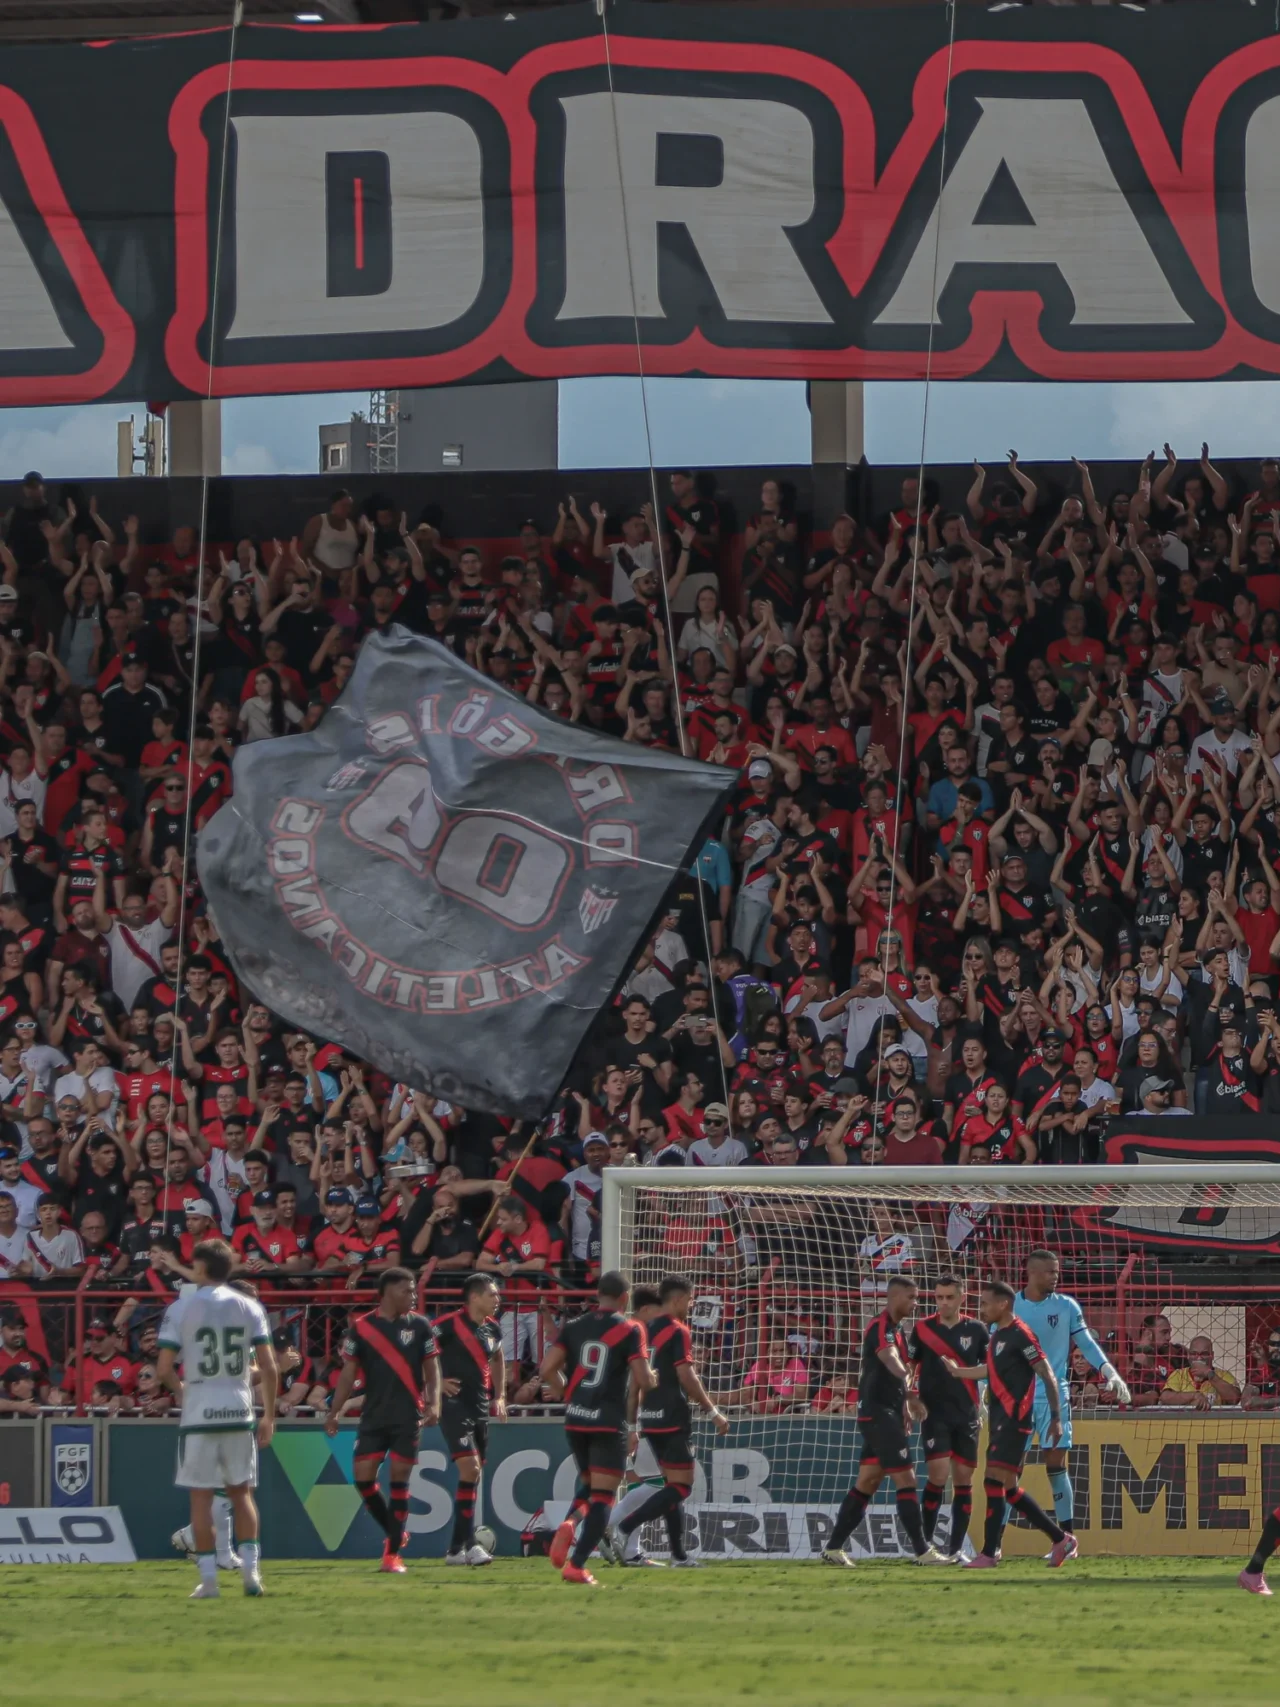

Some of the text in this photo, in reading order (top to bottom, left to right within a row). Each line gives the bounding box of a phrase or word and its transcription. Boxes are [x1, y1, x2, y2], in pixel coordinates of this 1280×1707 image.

[195, 1326, 245, 1378] 35
[580, 1340, 609, 1388] 9
[57, 1447, 88, 1457] FGF
